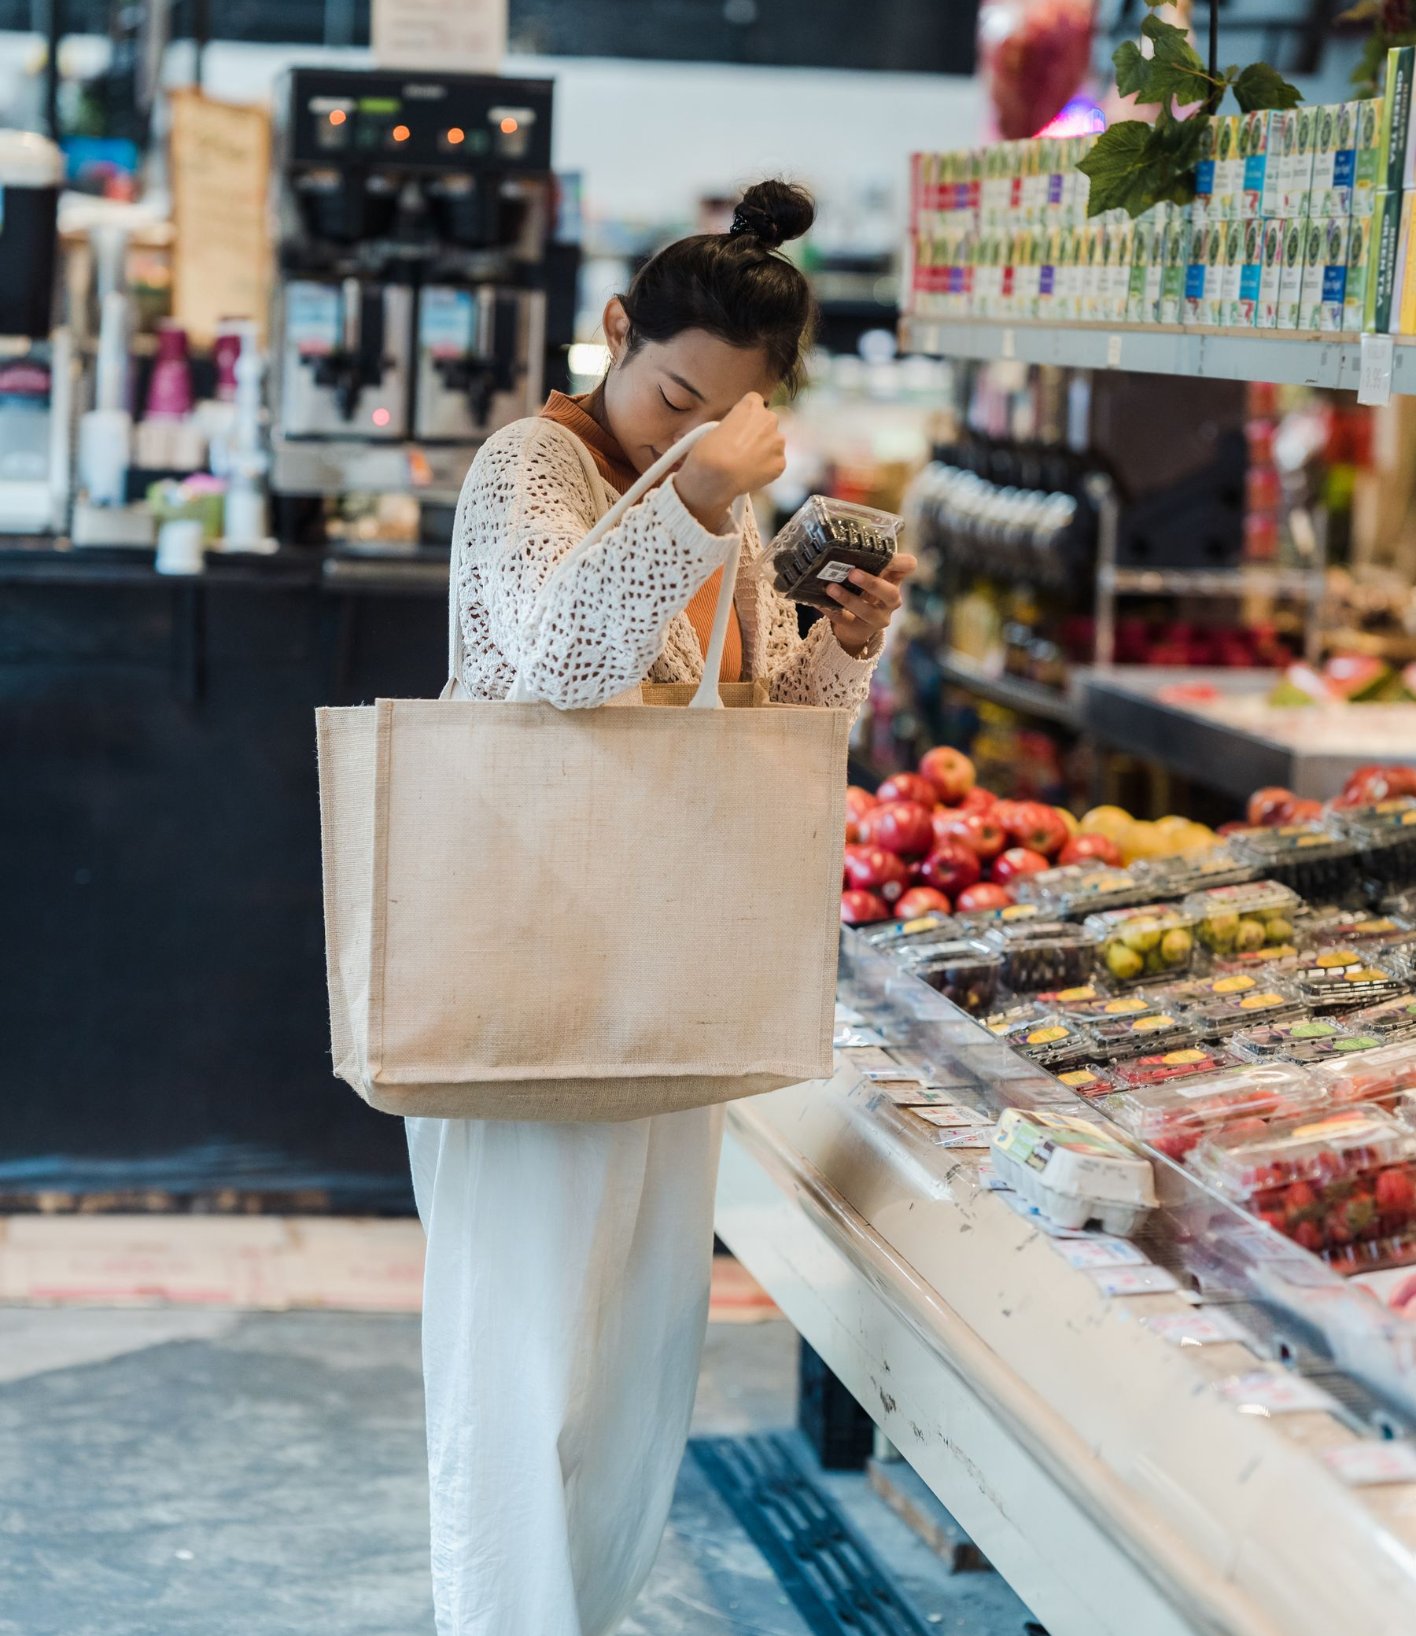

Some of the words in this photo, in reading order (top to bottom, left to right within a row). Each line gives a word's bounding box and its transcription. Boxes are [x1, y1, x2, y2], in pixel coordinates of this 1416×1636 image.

[1391, 70, 1404, 127] GREEN
[1389, 131, 1398, 164] TEA
[1380, 213, 1390, 271] GREEN
[1377, 274, 1386, 308] TEA
